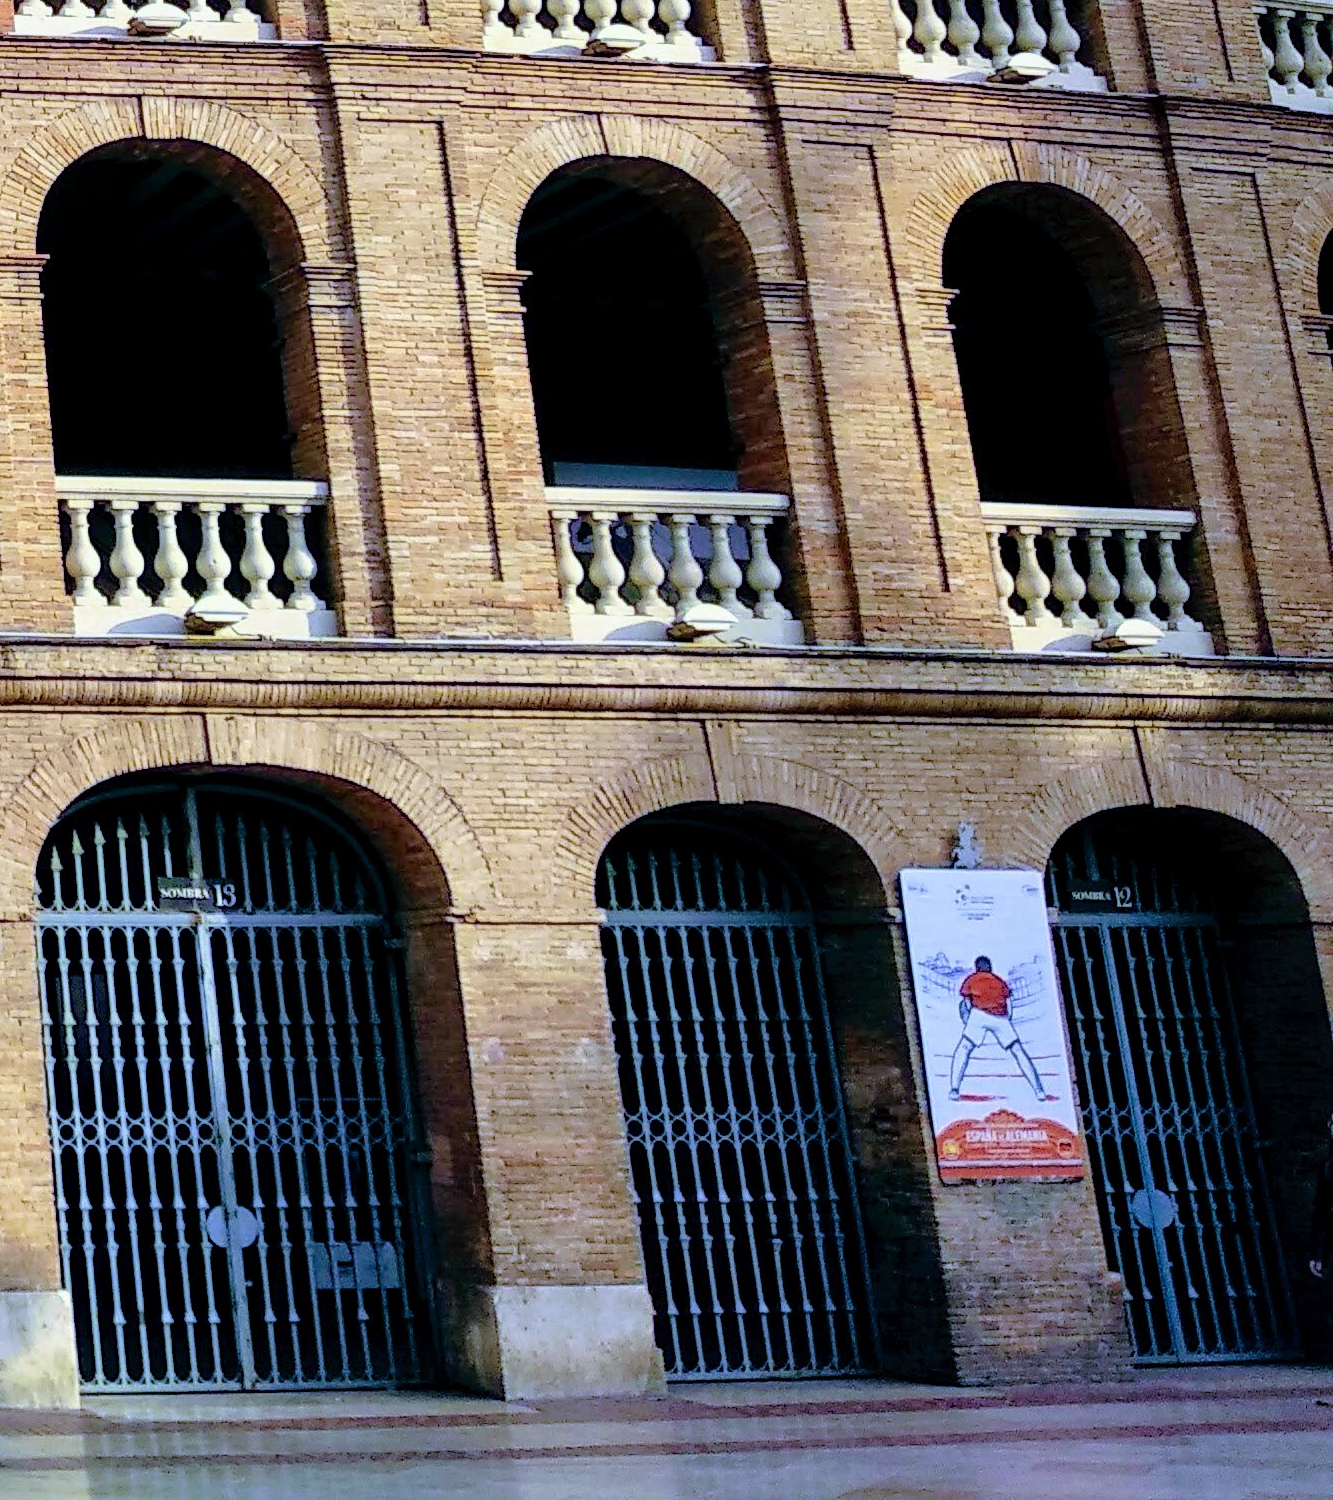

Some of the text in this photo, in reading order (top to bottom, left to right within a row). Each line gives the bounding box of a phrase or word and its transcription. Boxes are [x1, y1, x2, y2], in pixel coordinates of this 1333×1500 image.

[160, 884, 236, 907] SOMBRA 13
[1072, 886, 1132, 908] SOMBRA 12
